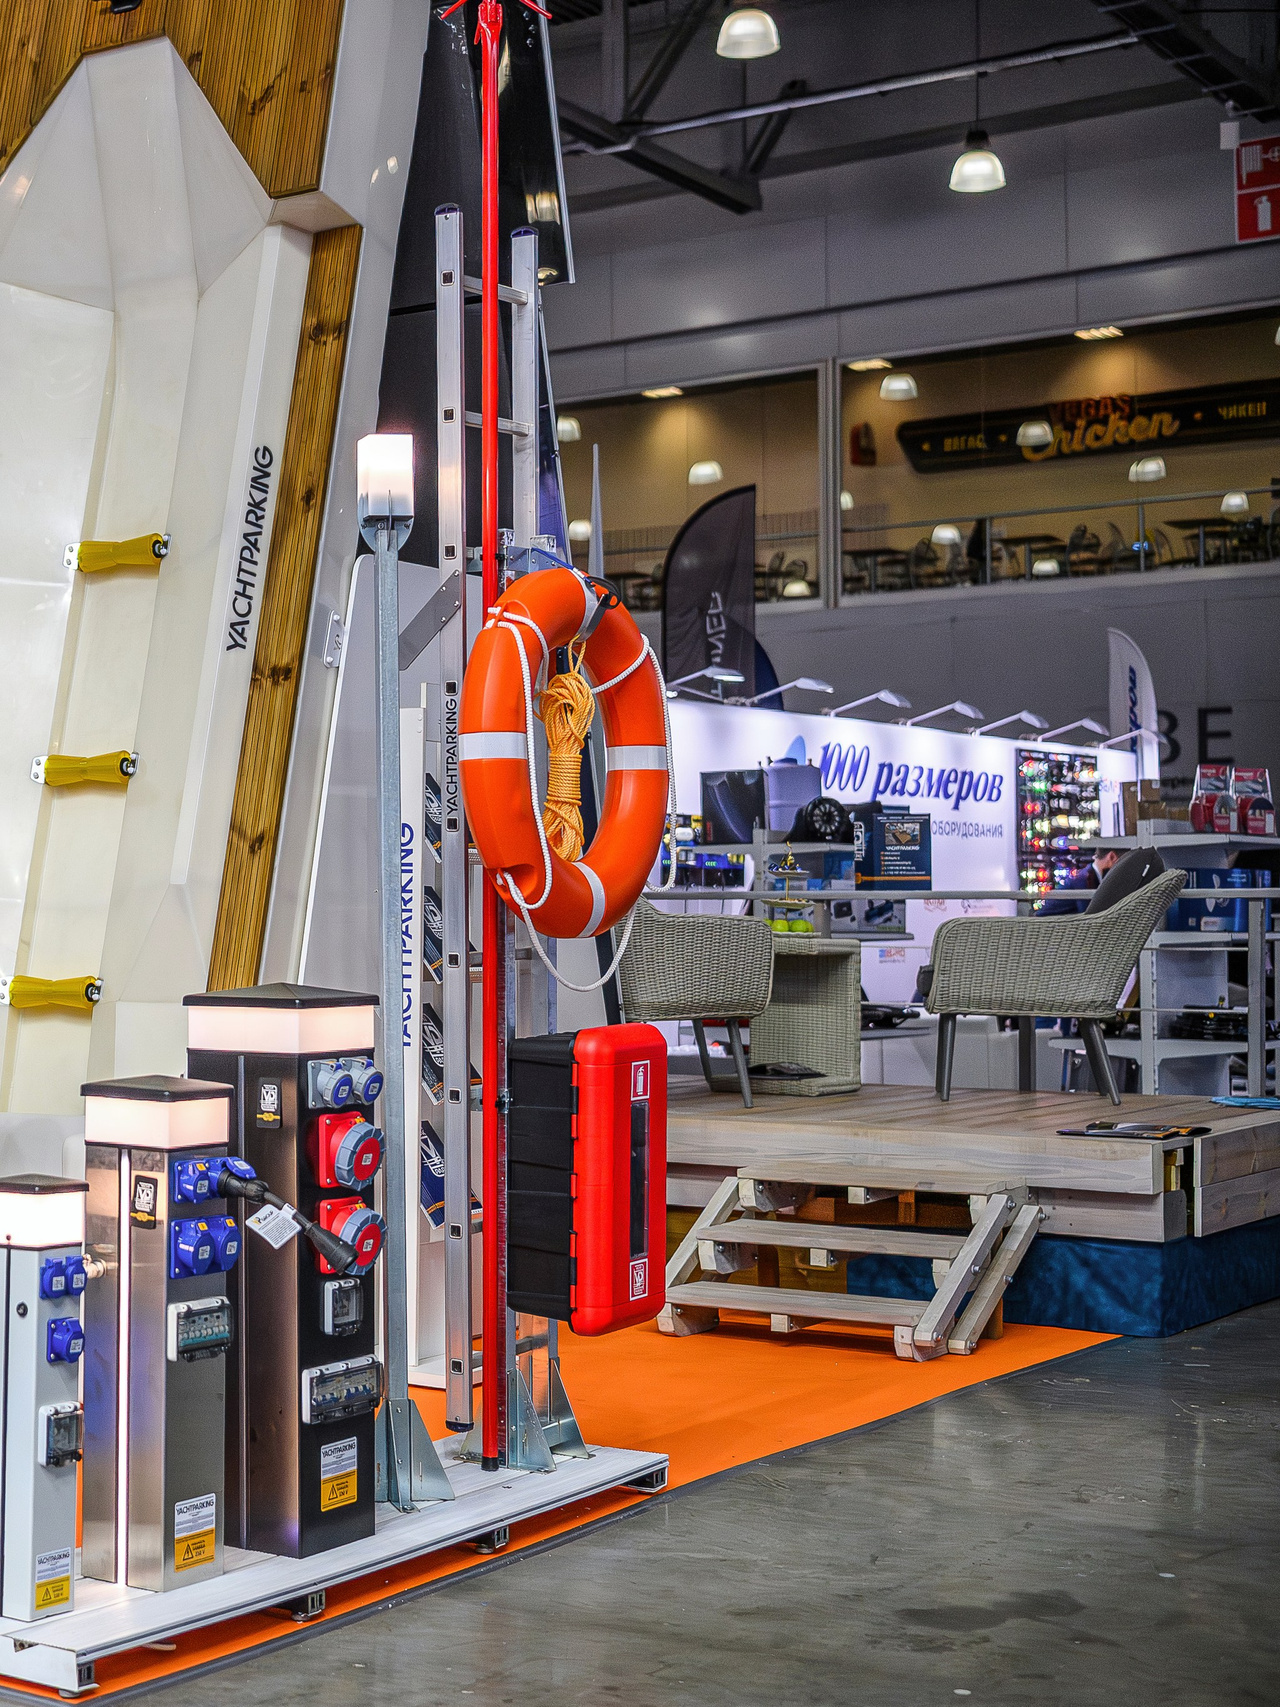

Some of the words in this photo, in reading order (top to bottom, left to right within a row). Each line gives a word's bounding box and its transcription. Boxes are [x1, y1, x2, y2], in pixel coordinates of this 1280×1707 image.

[226, 445, 274, 652] YACHTPARKING
[446, 698, 458, 815] YACHTPARKING
[820, 741, 870, 792] 1000
[872, 760, 1004, 811] размеров
[322, 1442, 356, 1458] YACHTPARKING
[176, 1499, 214, 1516] YACHTPARKING
